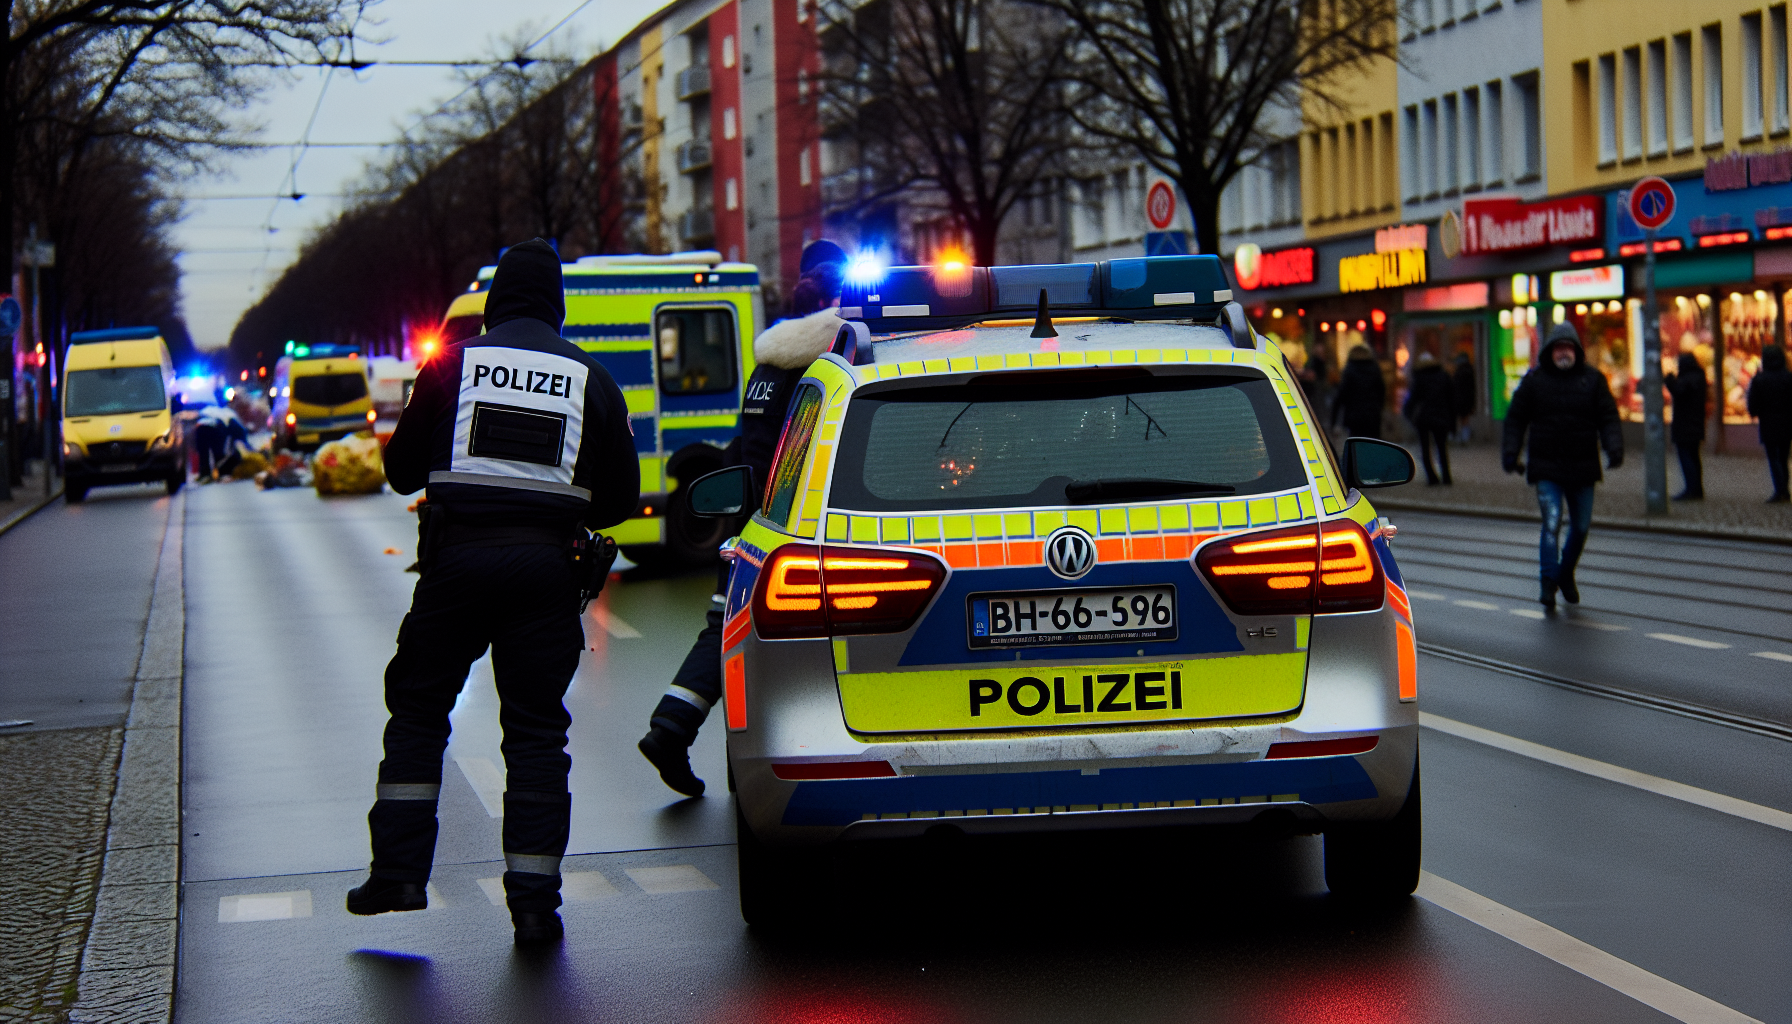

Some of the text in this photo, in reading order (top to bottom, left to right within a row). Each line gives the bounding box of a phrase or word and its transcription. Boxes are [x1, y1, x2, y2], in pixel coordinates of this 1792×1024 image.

[473, 364, 572, 399] POLIZEI
[991, 593, 1171, 634] BH-66-596
[968, 670, 1183, 717] POLIZEI
